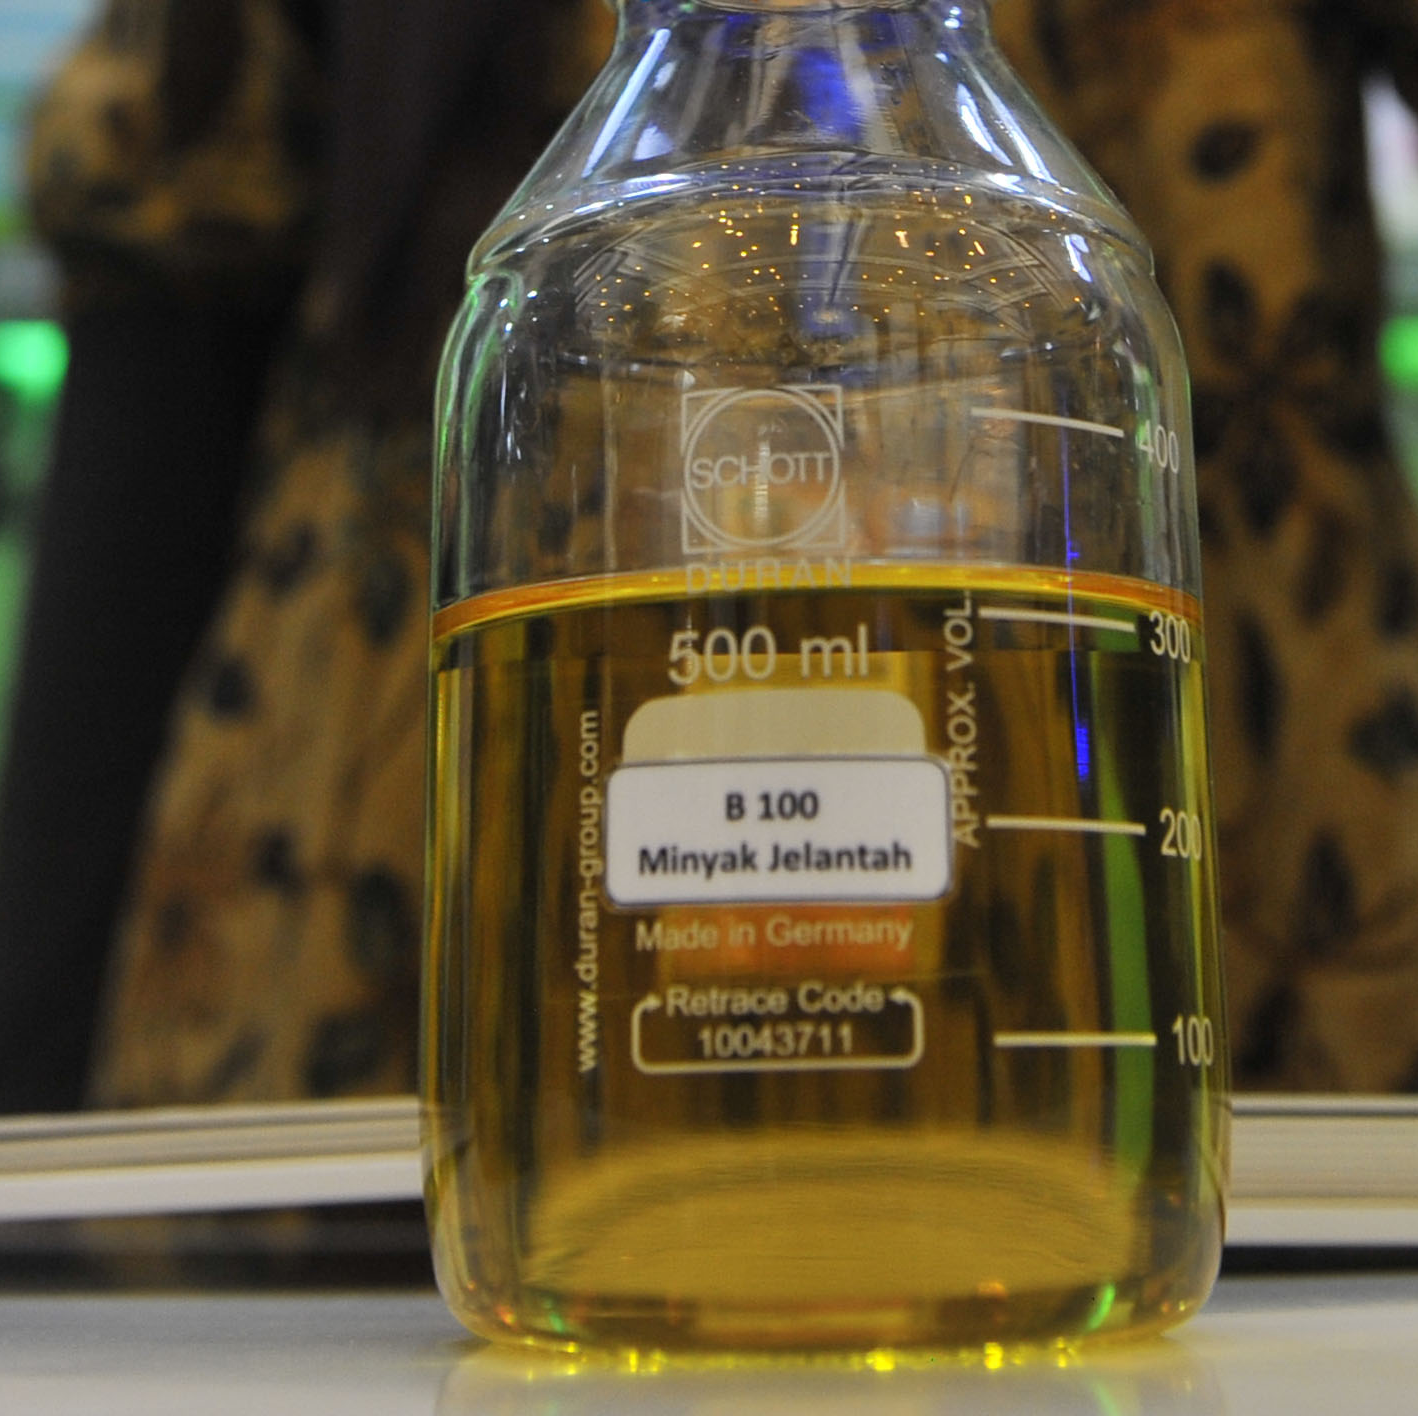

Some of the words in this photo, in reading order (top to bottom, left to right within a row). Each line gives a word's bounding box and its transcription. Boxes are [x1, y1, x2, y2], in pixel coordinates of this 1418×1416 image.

[691, 451, 831, 489] SCHOTT
[1138, 420, 1180, 474] 400
[686, 556, 852, 595] DURAN
[667, 626, 778, 685] 500
[800, 624, 869, 677] ml
[943, 591, 974, 672] VOL.
[1149, 610, 1192, 663] 300
[946, 682, 982, 849] APPROX.
[726, 791, 746, 821] B
[758, 790, 819, 821] 100
[1160, 807, 1202, 861] 200
[638, 842, 758, 880] Minyak
[768, 840, 912, 873] Jelantah
[574, 709, 603, 1072] www.duran-group.com
[635, 919, 722, 951] Made
[728, 919, 756, 948] in
[765, 915, 915, 951] Germany
[665, 985, 789, 1017] Retrace
[798, 981, 886, 1012] Code
[697, 1022, 854, 1058] 10043711
[1172, 1015, 1213, 1066] 100
